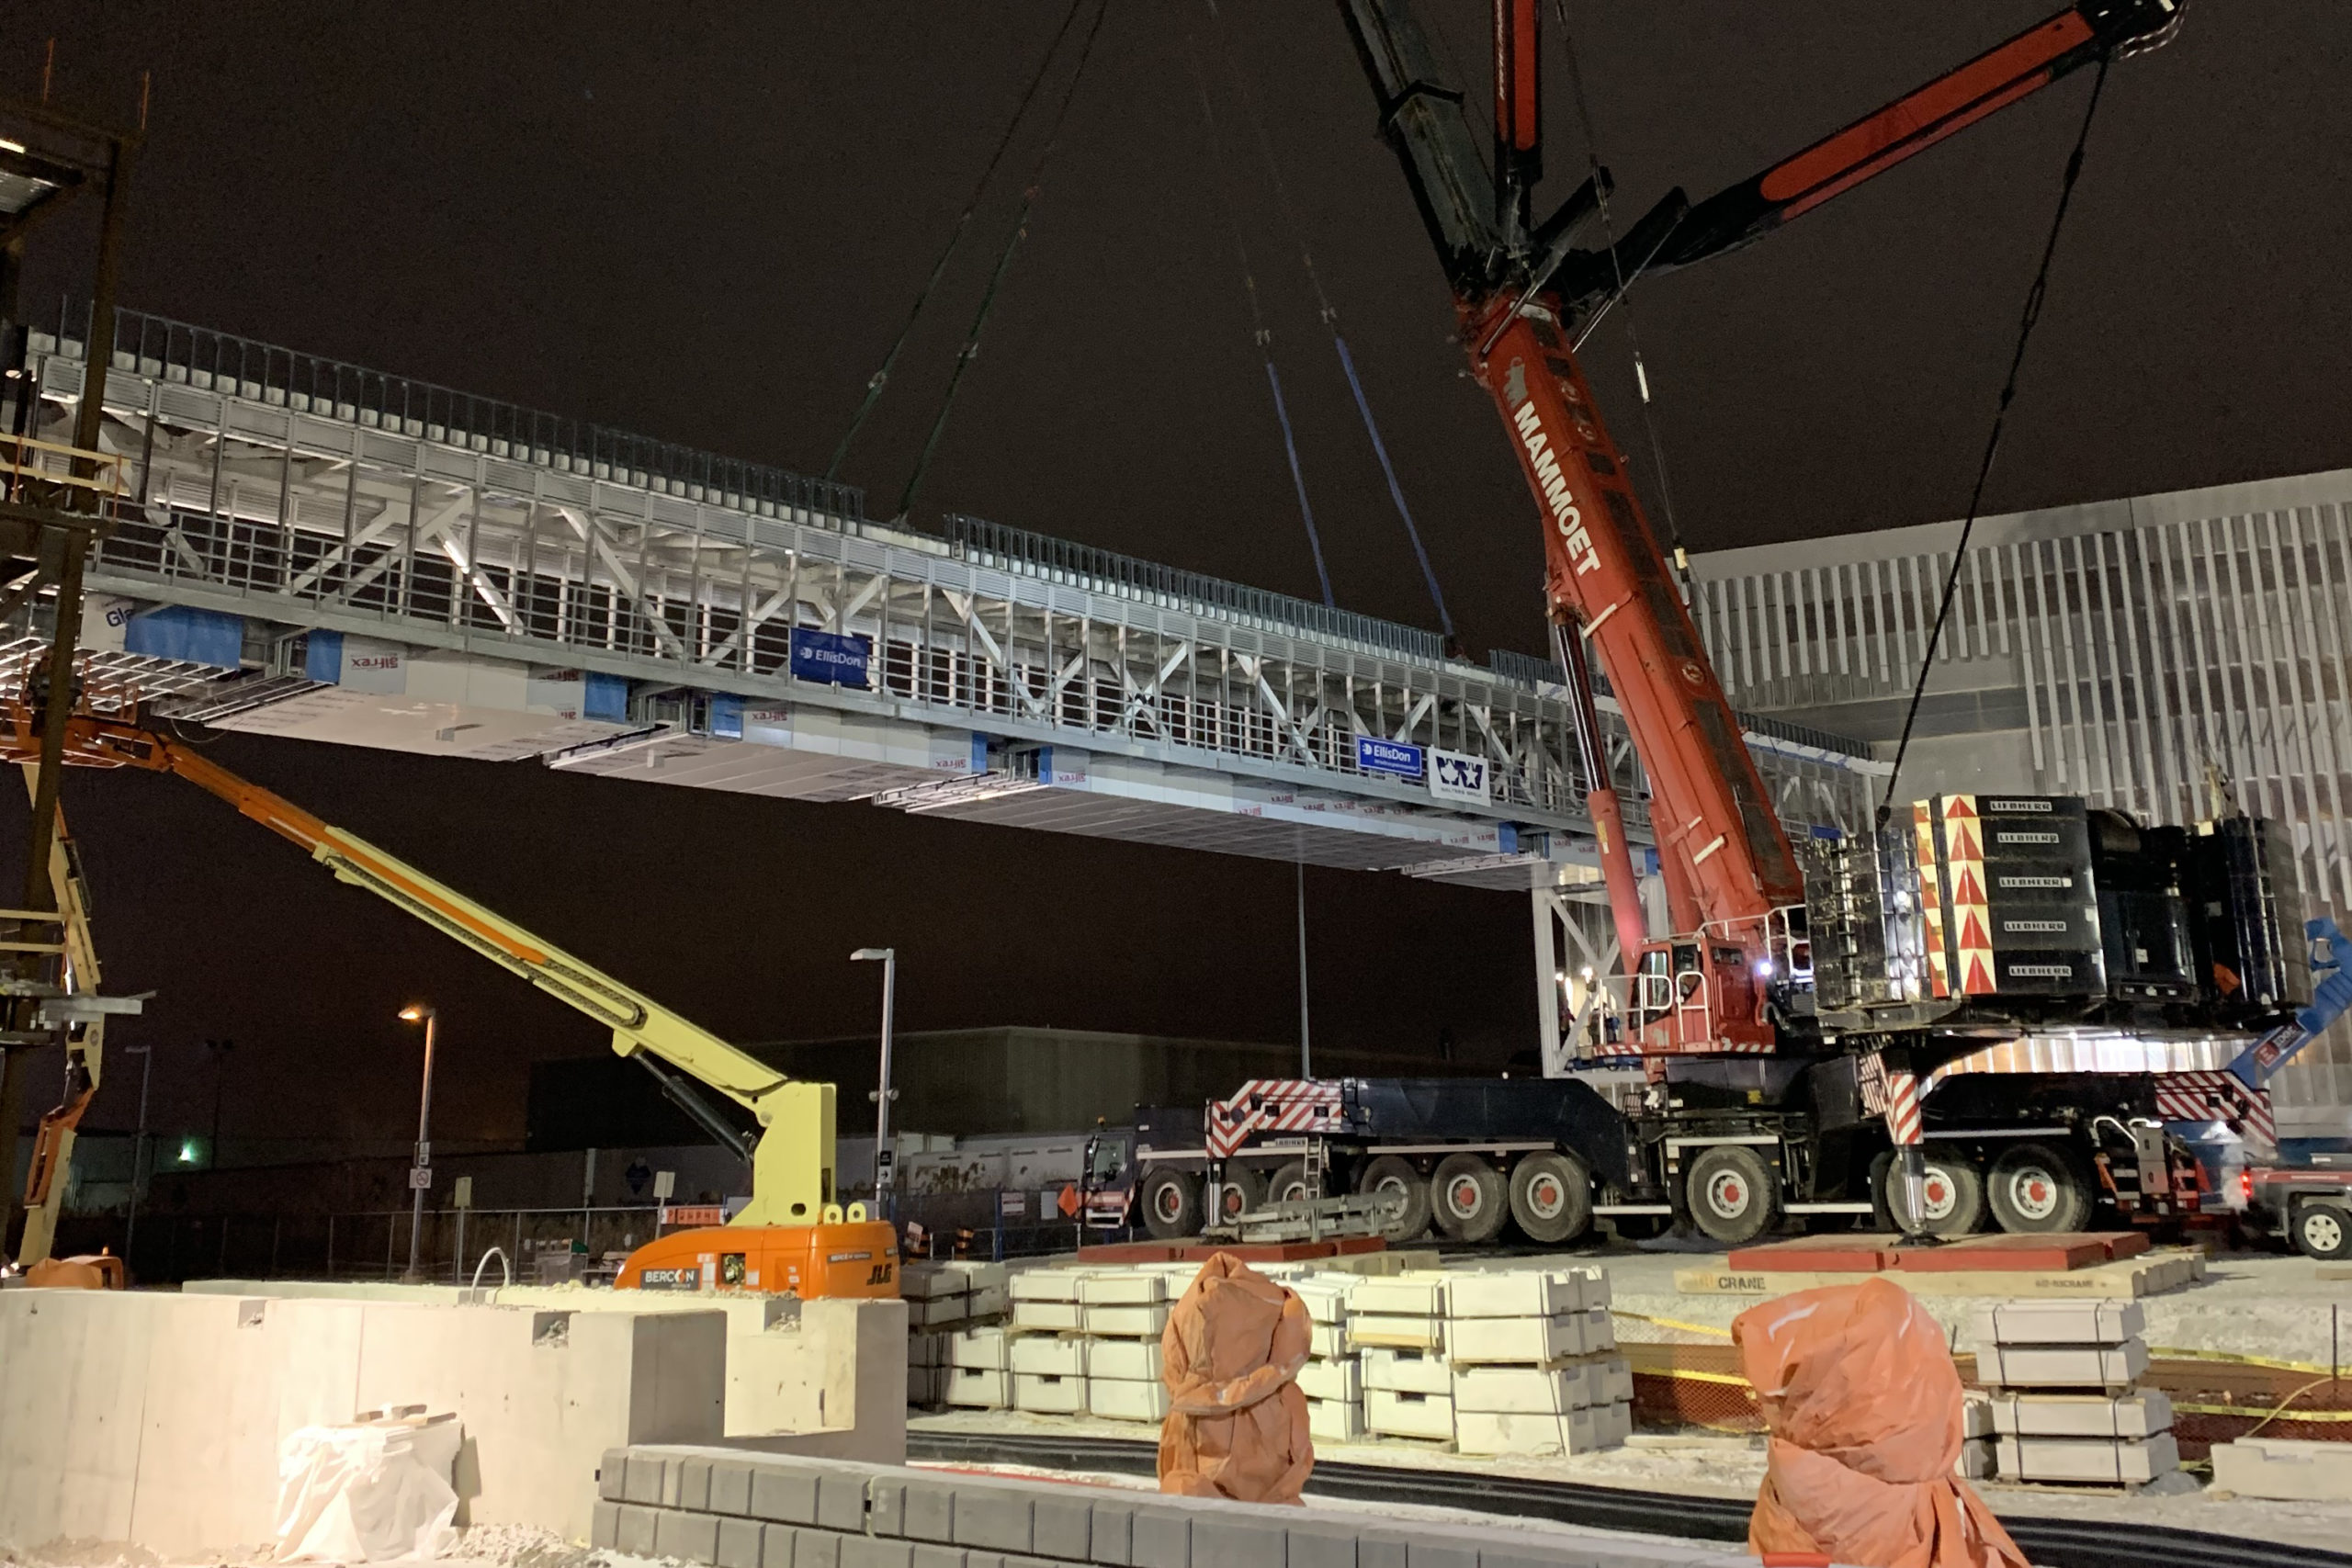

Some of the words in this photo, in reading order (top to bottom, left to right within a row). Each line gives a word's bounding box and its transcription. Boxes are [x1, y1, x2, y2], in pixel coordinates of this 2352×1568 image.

[1514, 400, 1601, 577] MAMMOET
[352, 657, 399, 669] alfrex
[815, 649, 861, 667] EllisDon
[1374, 745, 1411, 762] EllisDon
[935, 758, 967, 769] alfrex
[1991, 801, 2052, 811] LIEBHERR
[645, 1269, 695, 1283] BERCON
[866, 1263, 892, 1286] JLG
[1718, 1276, 1766, 1290] CRANE
